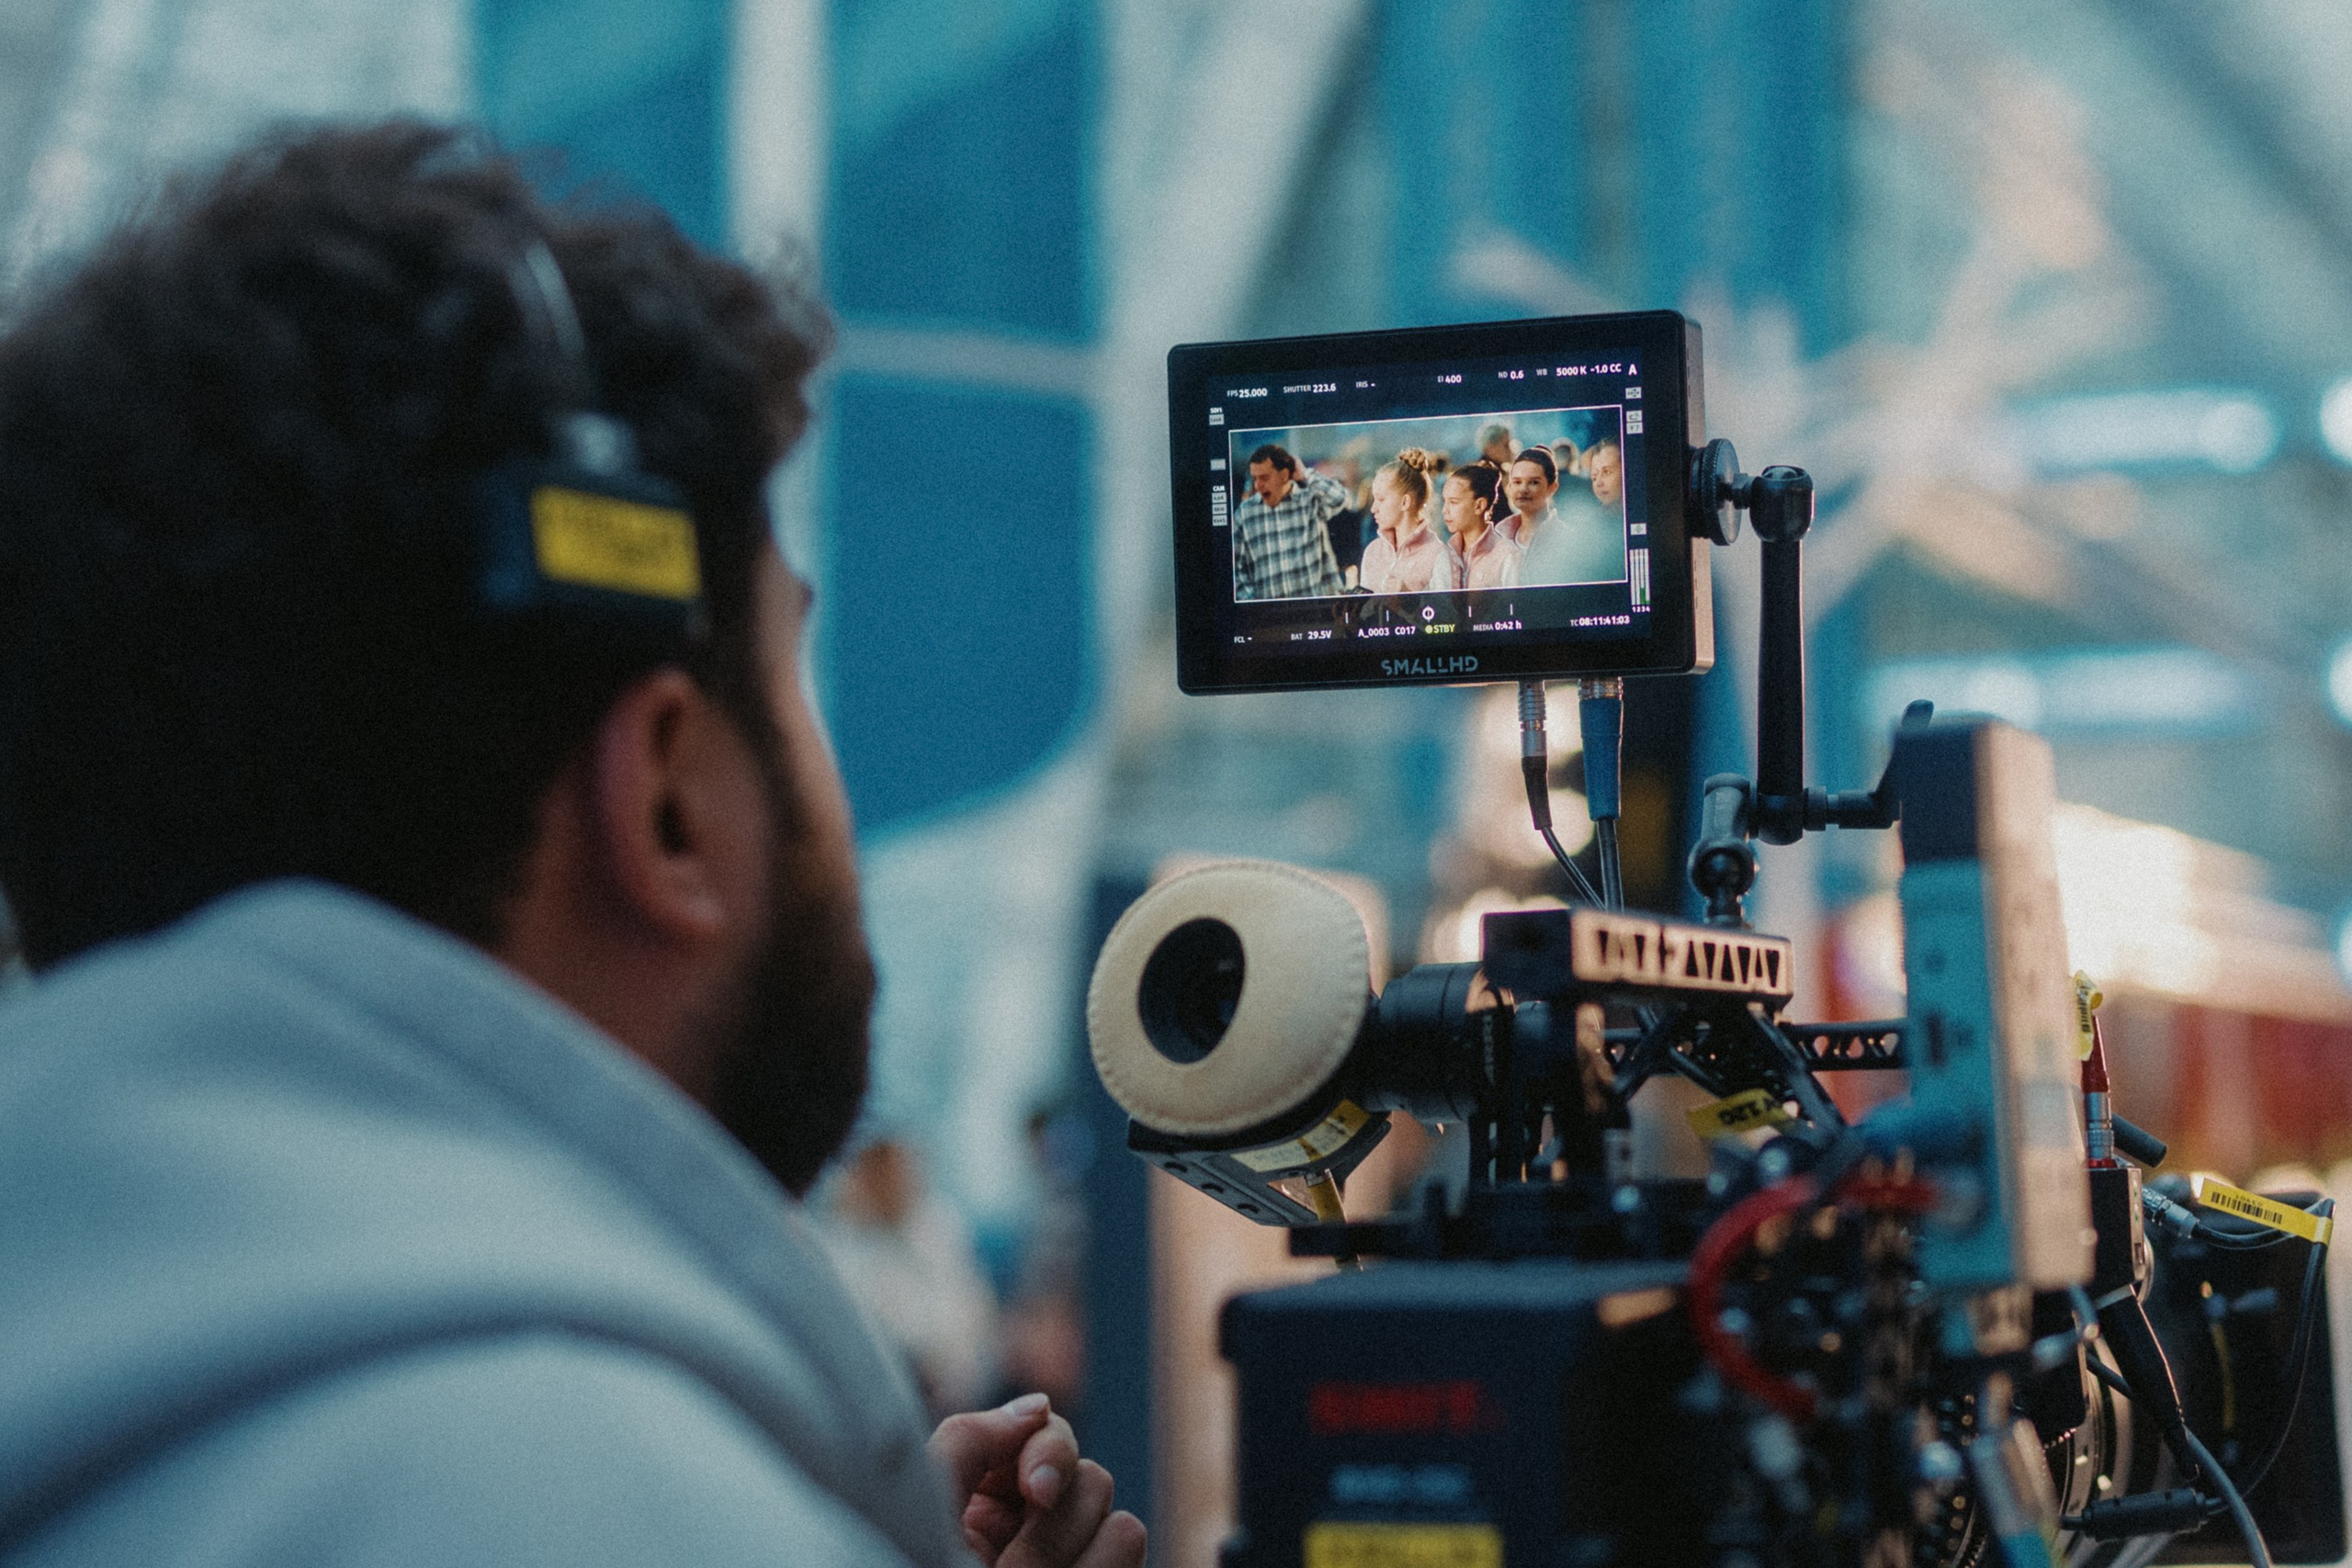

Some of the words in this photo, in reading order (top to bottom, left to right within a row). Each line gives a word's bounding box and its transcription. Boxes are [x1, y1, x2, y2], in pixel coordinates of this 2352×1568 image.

[1510, 370, 1524, 379] 0.6
[1556, 367, 1578, 377] 5000
[1580, 366, 1587, 375] K
[1590, 365, 1608, 374] -1.0
[1610, 363, 1622, 372] CC
[1628, 364, 1637, 376] A
[1445, 375, 1462, 384] 400
[1227, 389, 1238, 398] FPS
[1238, 388, 1268, 398] 25.000
[1283, 385, 1311, 394] SHUTTER
[1313, 383, 1336, 393] 223.6
[1473, 624, 1494, 632] MEDIA
[1495, 621, 1514, 631] 0:42
[1516, 620, 1522, 629] h
[1570, 618, 1578, 626] TC
[1357, 627, 1390, 638] A_0003
[1394, 626, 1416, 636] C017
[1433, 624, 1455, 634] STBY
[1307, 630, 1332, 639] 29.5V
[1381, 656, 1479, 676] SMALLHD
